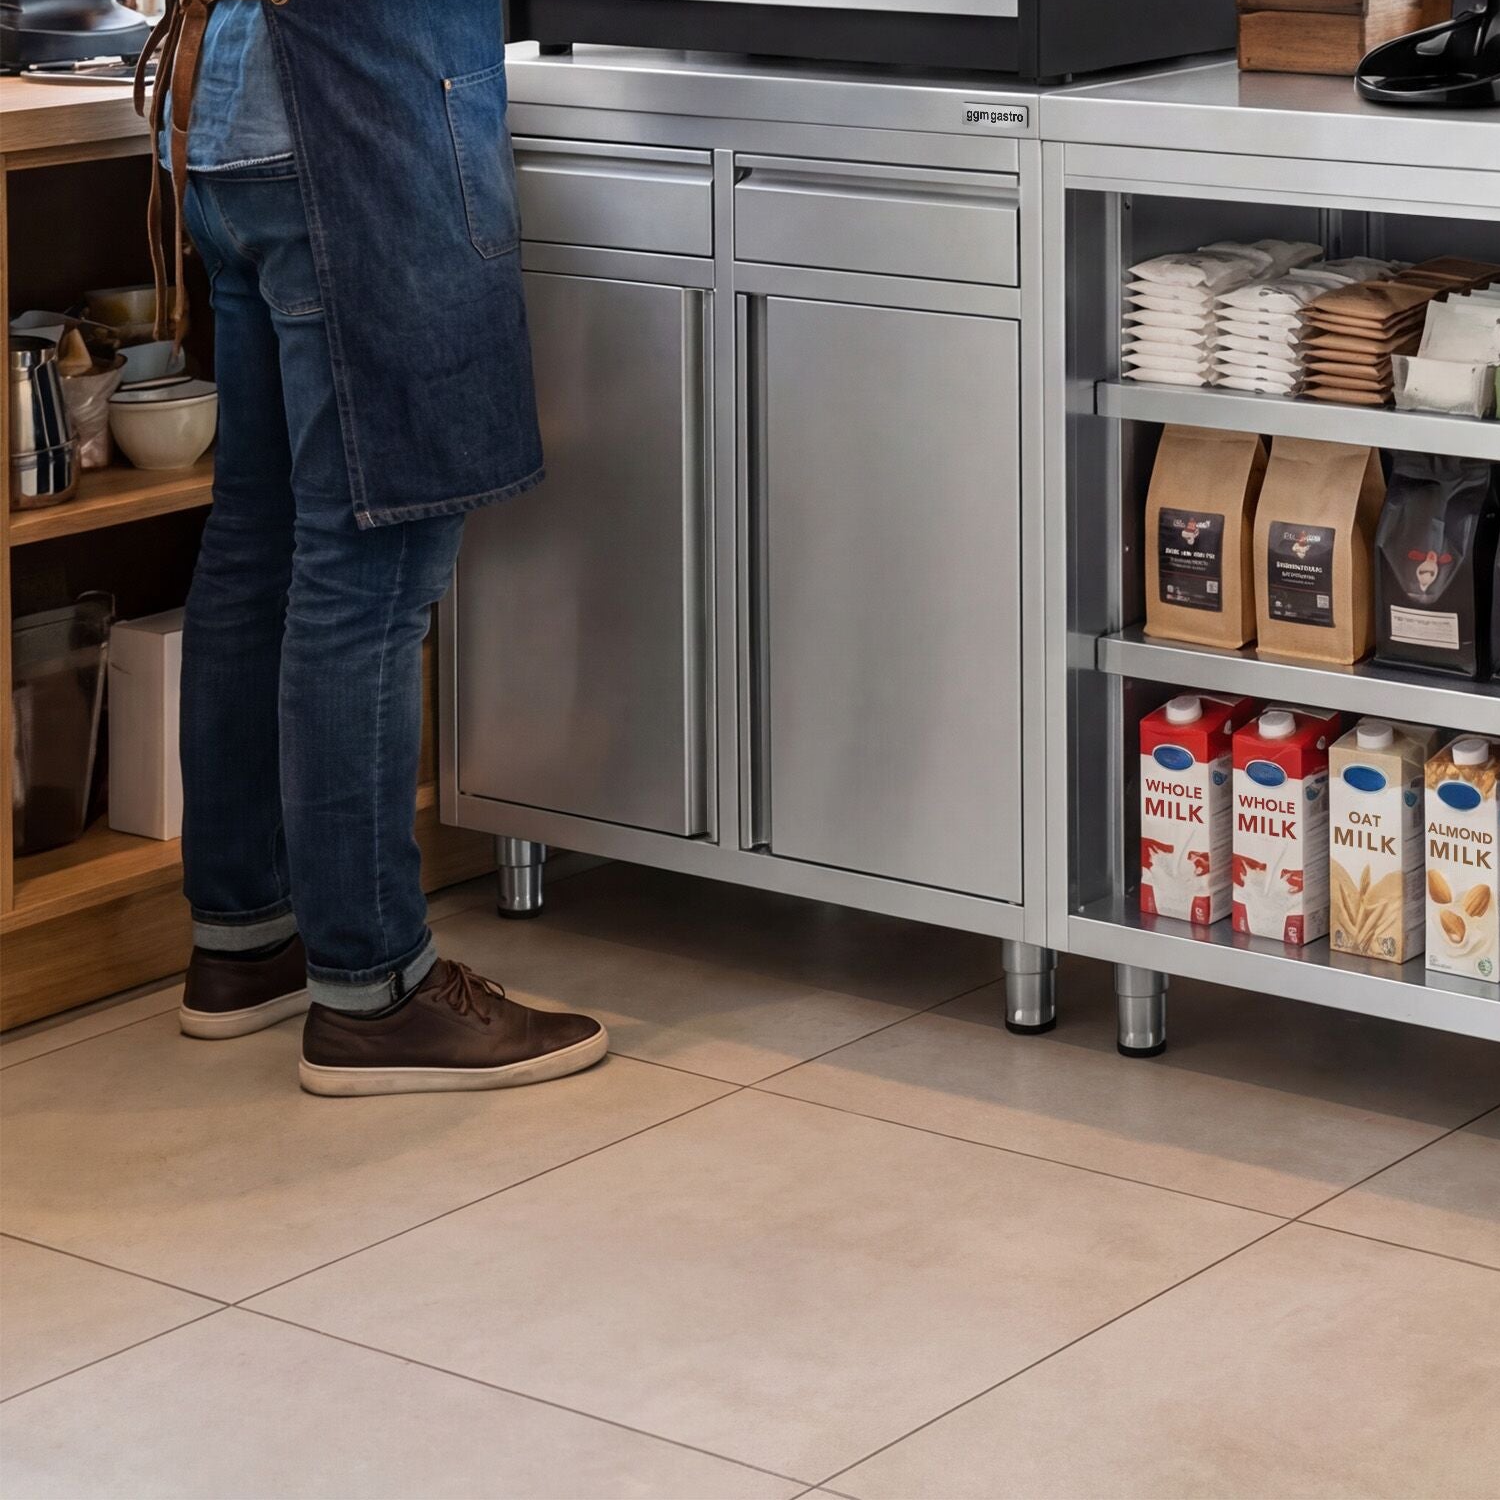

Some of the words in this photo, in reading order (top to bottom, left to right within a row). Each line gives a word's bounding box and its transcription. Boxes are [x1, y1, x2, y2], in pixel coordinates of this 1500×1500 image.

[1145, 778, 1203, 800] WHOLE
[1145, 797, 1204, 824] MILK
[1238, 794, 1296, 815] WHOLE
[1238, 813, 1297, 840] MILK
[1348, 811, 1382, 828] OAT
[1334, 826, 1397, 856] MILK
[1427, 821, 1493, 845] ALMOND
[1430, 839, 1493, 870] MILK
